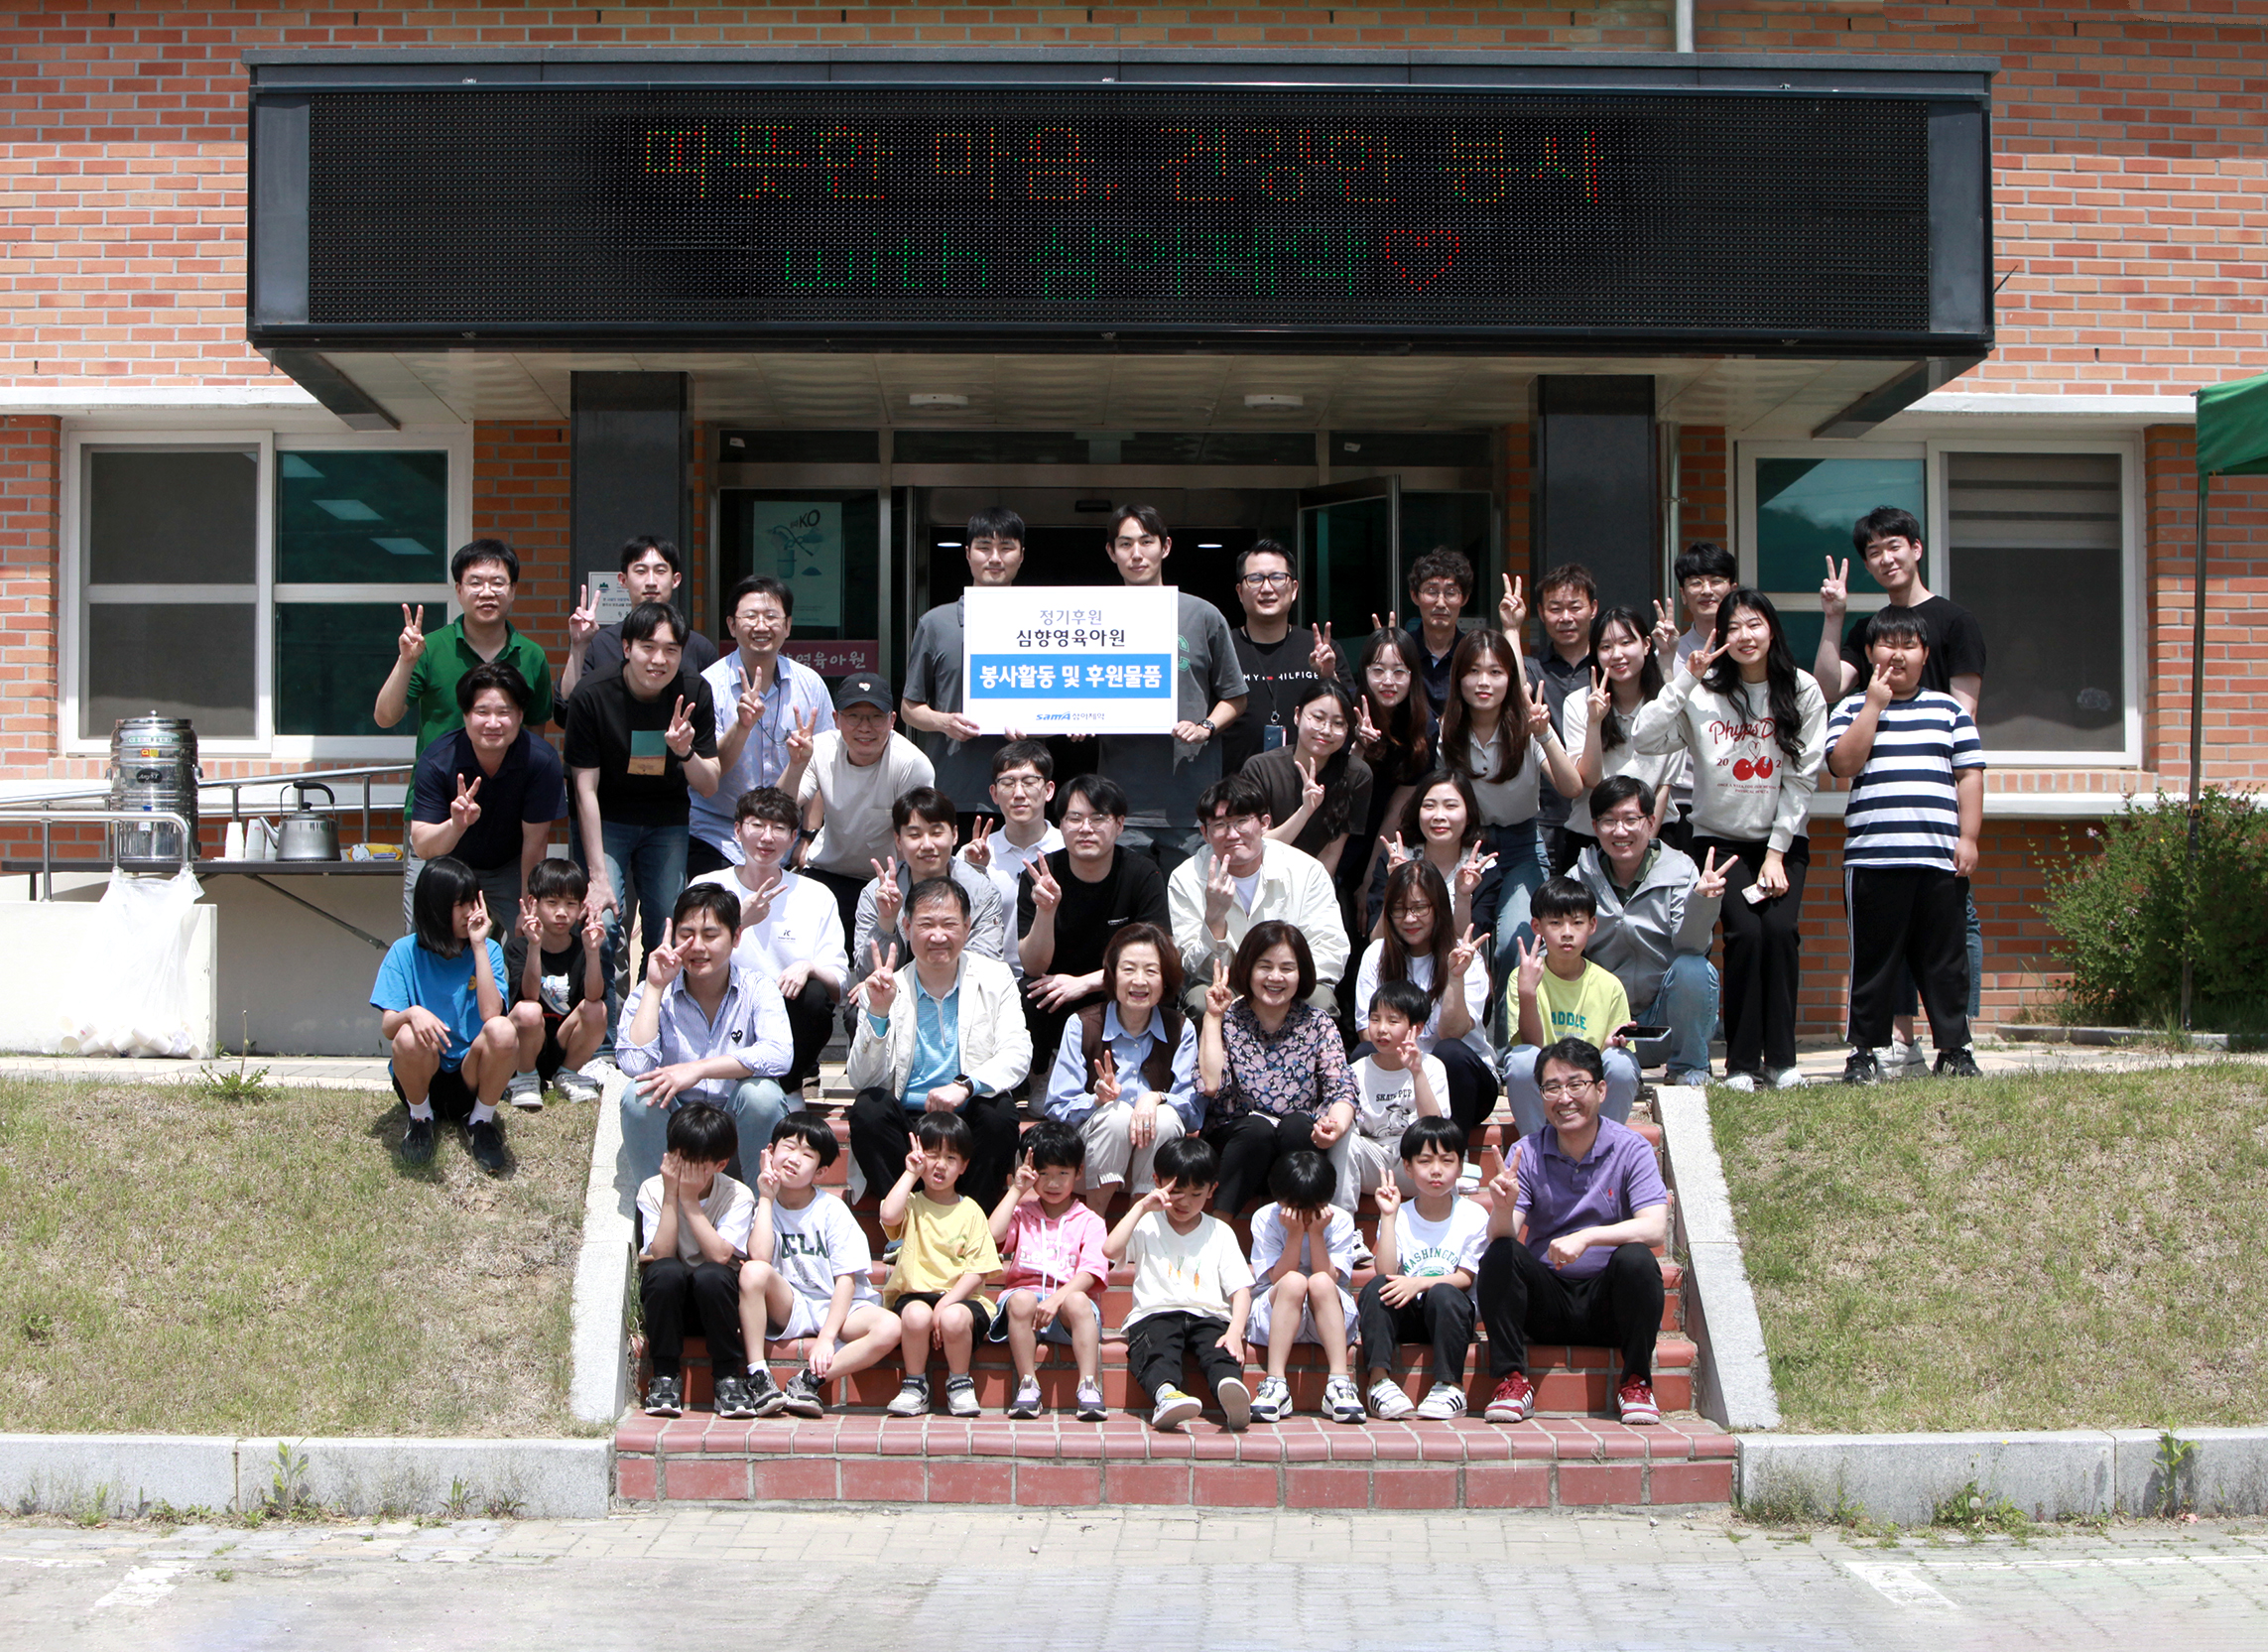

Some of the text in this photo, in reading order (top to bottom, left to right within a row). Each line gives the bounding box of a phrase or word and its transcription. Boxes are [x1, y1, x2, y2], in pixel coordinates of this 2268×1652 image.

[784, 231, 987, 289] with
[1040, 609, 1102, 626] 정기후원
[1016, 629, 1125, 648] 심향영육아원
[779, 651, 866, 670] 영육아원
[979, 665, 1162, 689] 봉사활동 및 후원물품
[1716, 758, 1728, 767] 20
[1403, 1247, 1458, 1273] WASHINGTO
